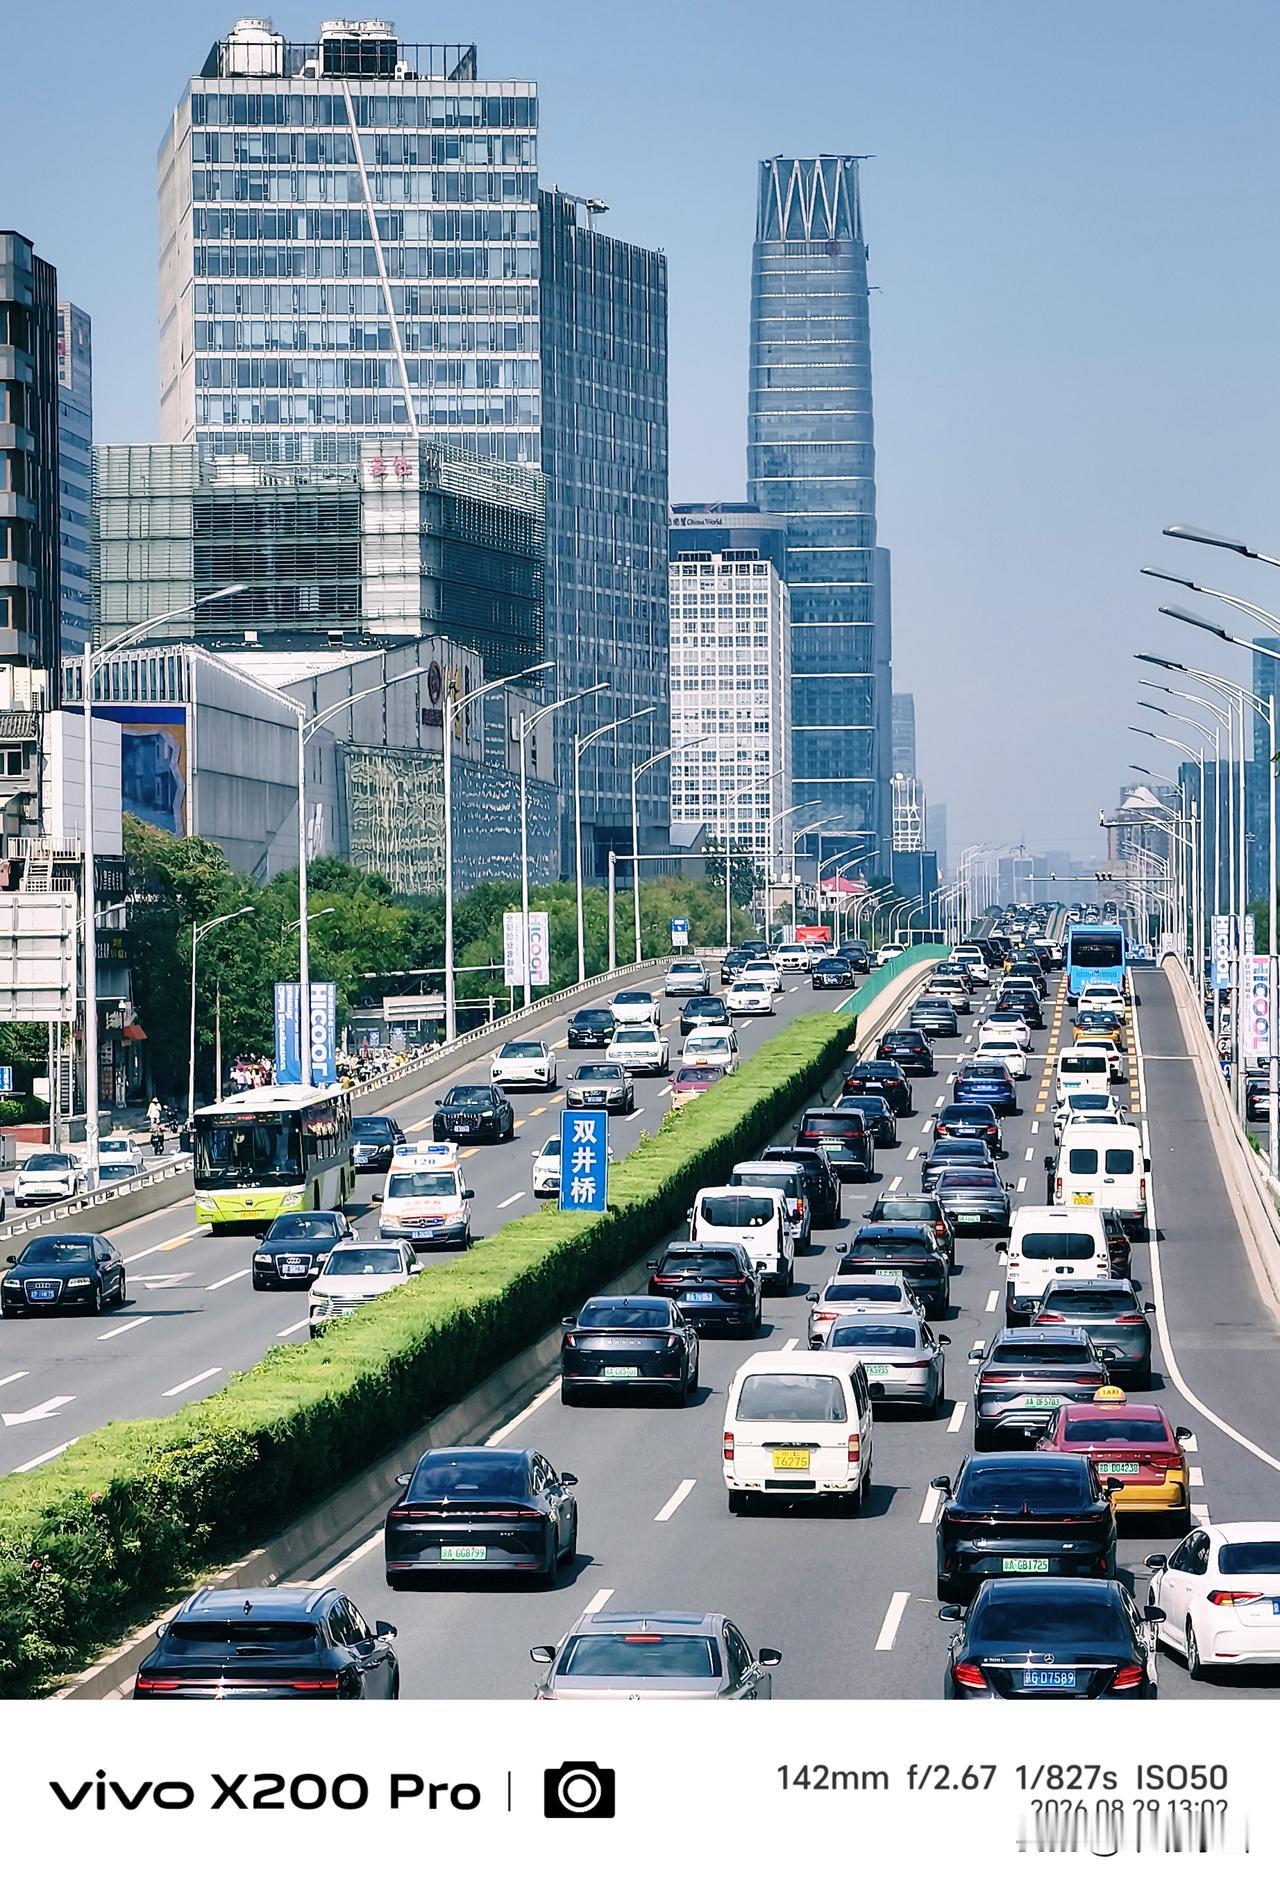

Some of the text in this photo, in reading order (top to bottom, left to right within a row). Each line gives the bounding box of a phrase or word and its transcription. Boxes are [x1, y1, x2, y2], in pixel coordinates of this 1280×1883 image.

[1216, 915, 1229, 984] HICOOL
[1253, 957, 1268, 1050] HICOOL
[570, 1120, 598, 1204] 双井桥
[775, 1456, 808, 1467] T6275
